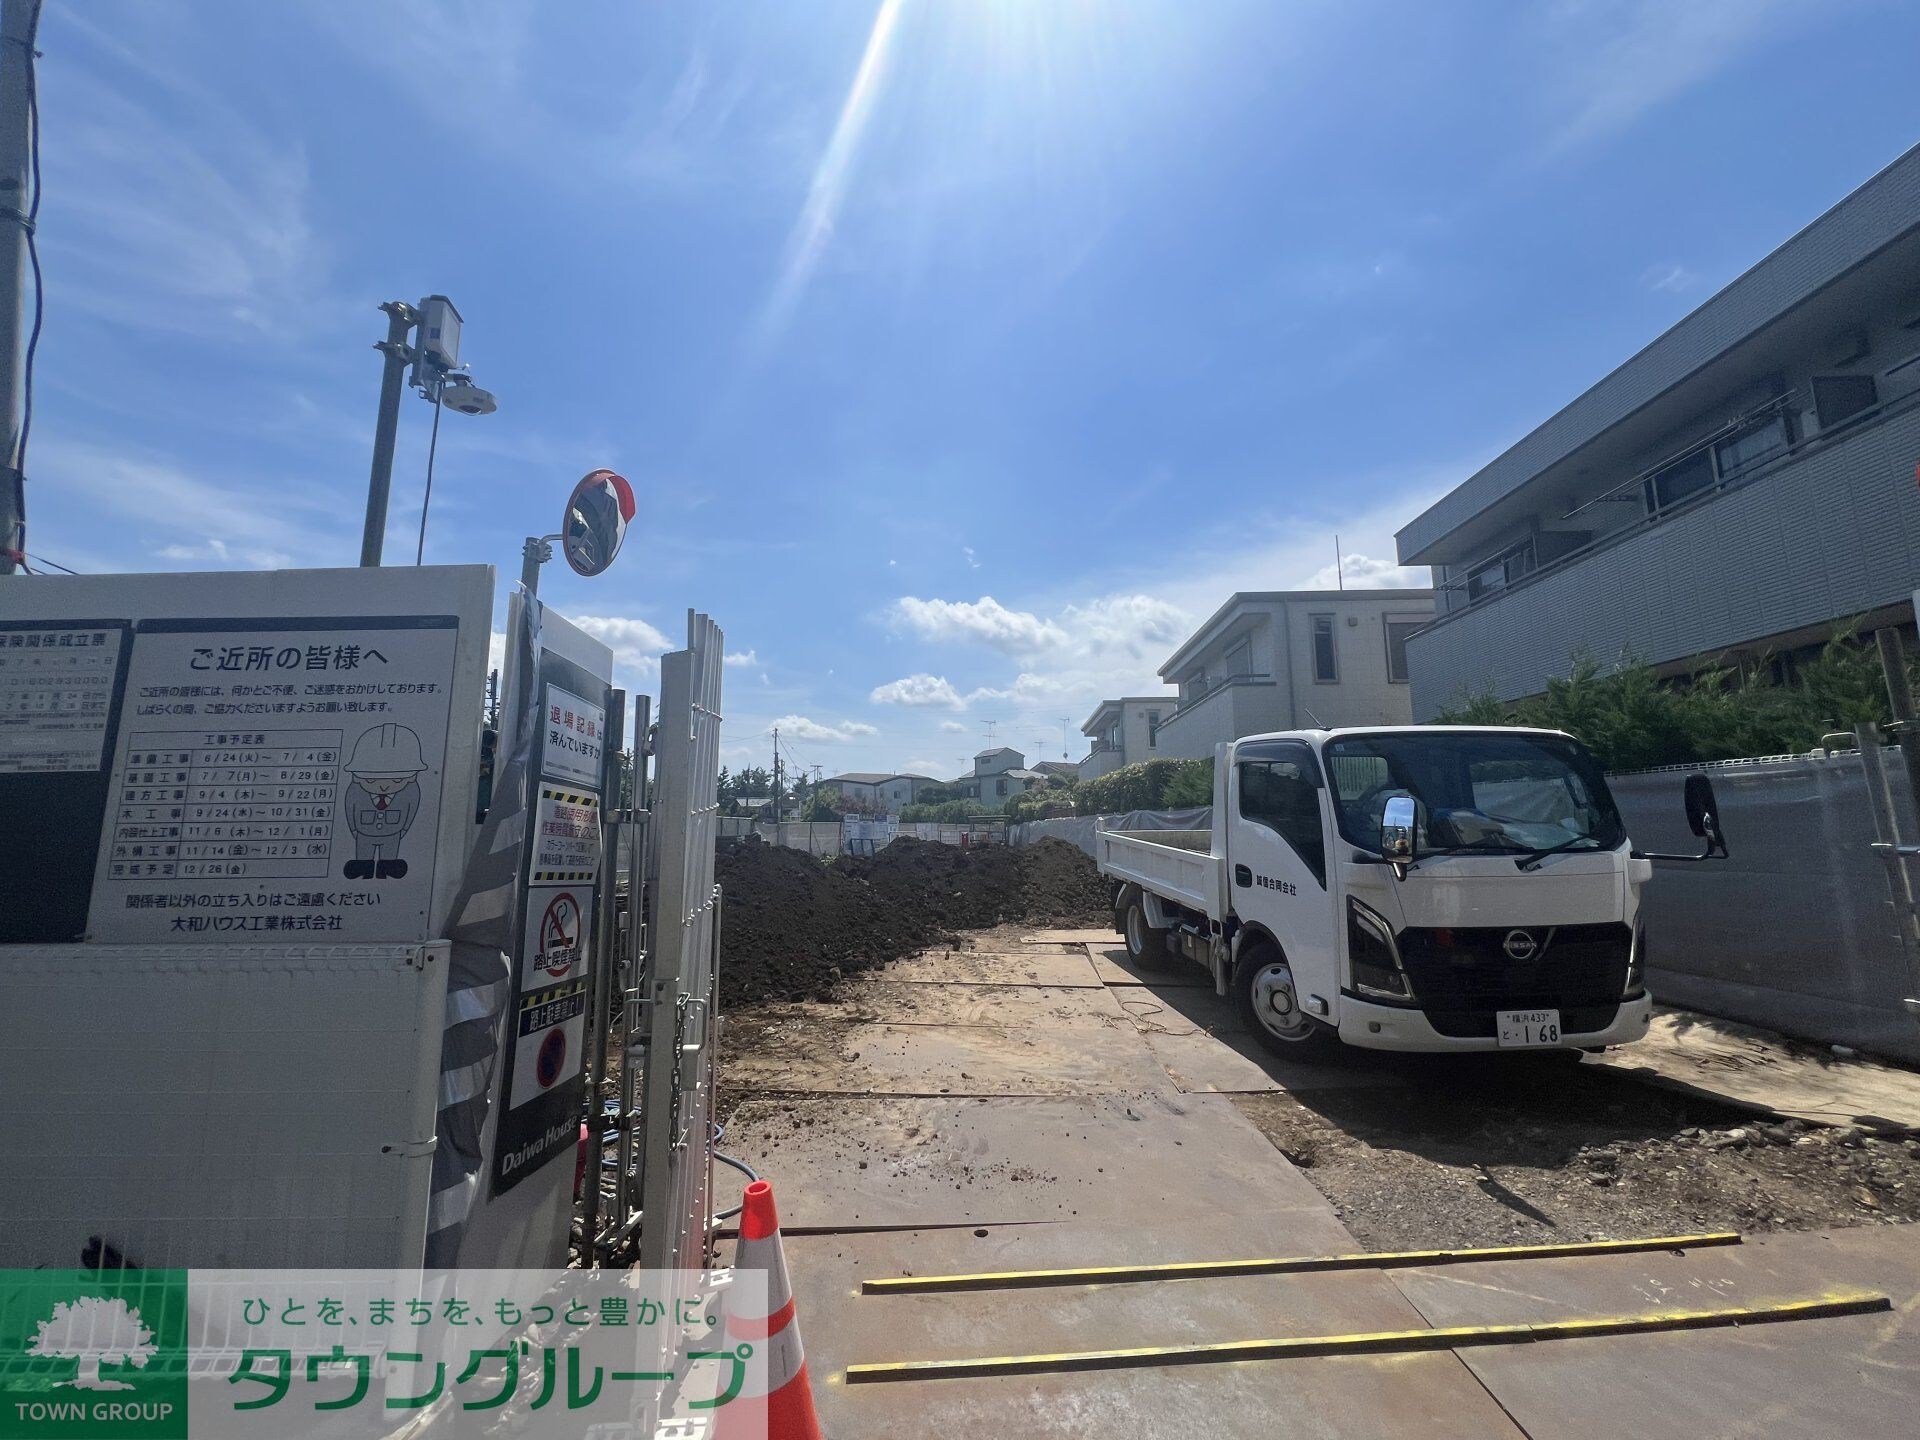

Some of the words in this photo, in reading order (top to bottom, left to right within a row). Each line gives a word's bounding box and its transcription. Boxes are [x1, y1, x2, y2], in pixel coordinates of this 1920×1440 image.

[190, 645, 389, 671] ご近所の皆様へ
[204, 734, 265, 745] 工事予定表
[126, 893, 381, 909] 関係者以外の立ち入りはご遠慮ください
[170, 915, 343, 932] 大和ハウス工業株式会社
[1503, 941, 1537, 949] NISSAN
[502, 1142, 544, 1176] Daiwa
[545, 1115, 577, 1148] House
